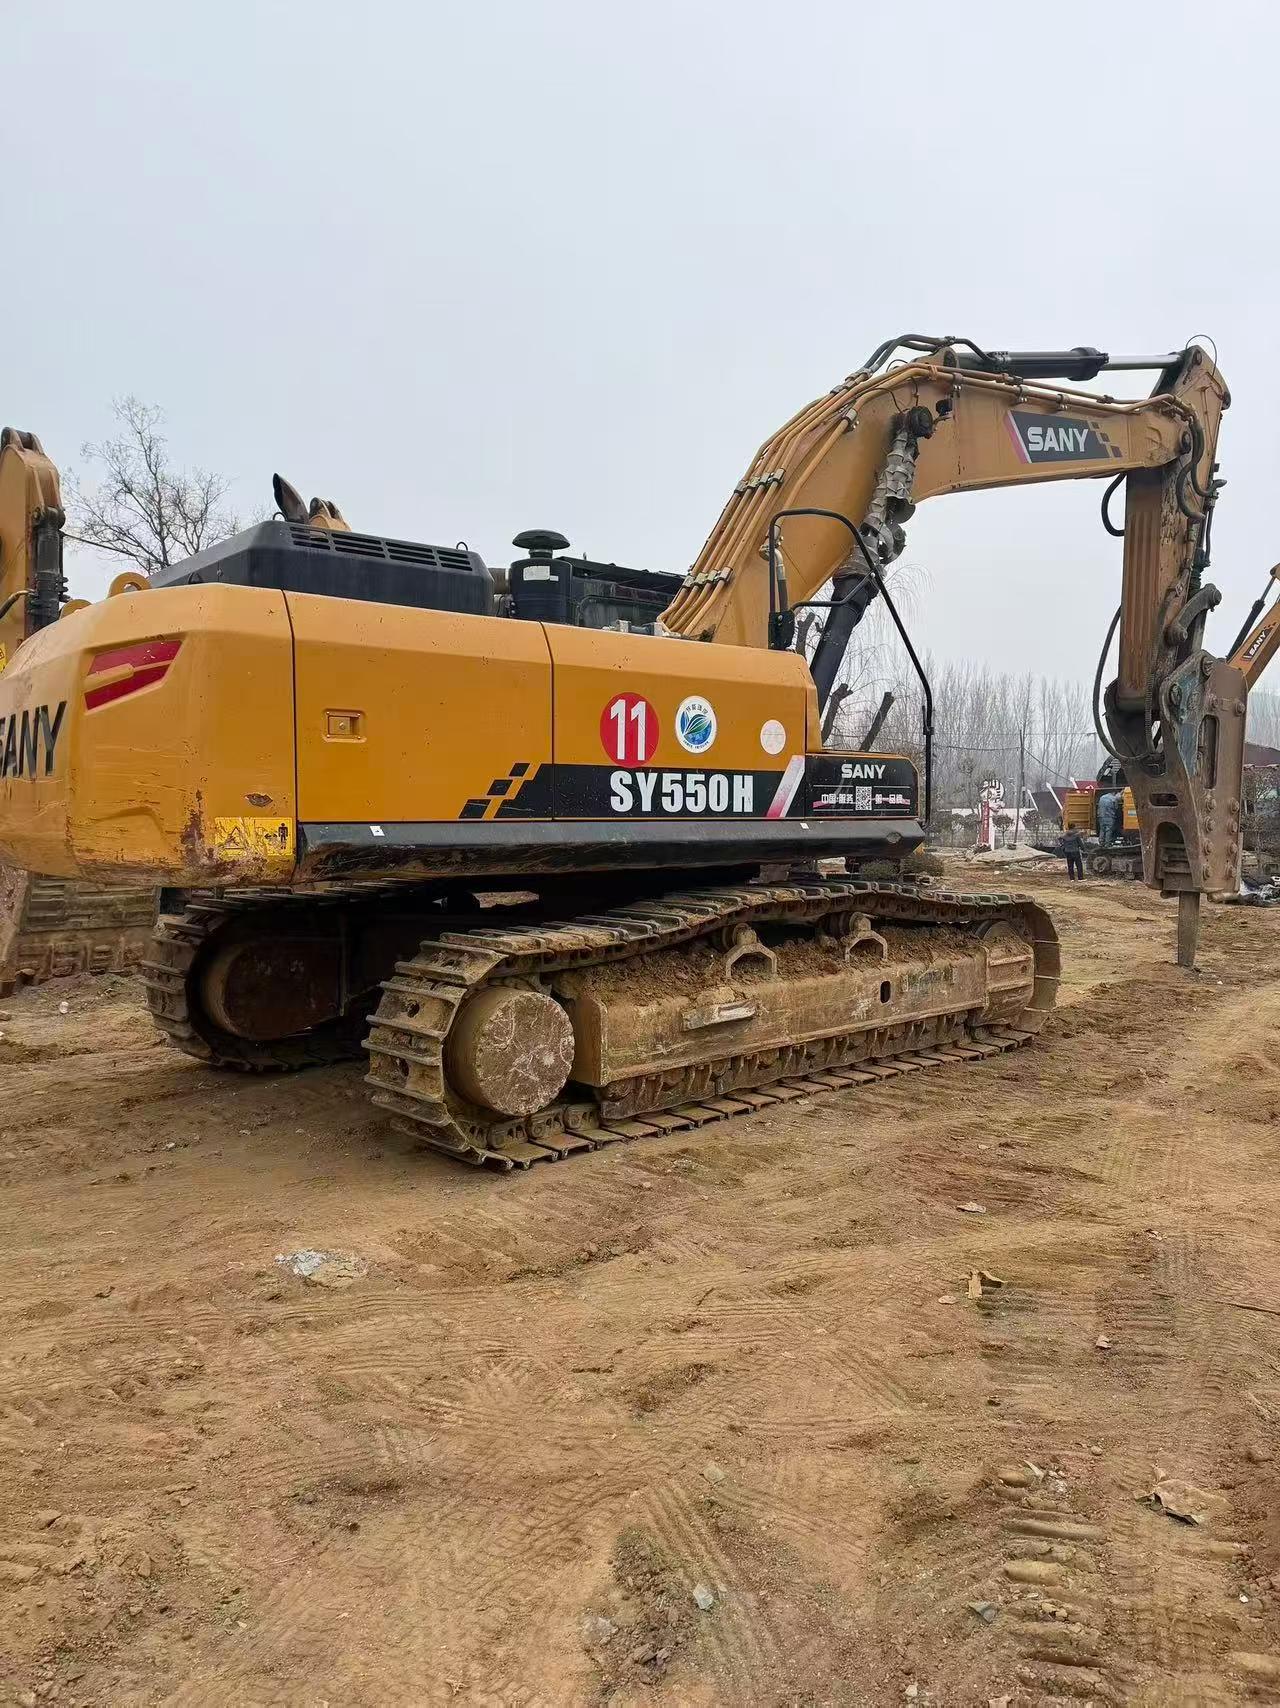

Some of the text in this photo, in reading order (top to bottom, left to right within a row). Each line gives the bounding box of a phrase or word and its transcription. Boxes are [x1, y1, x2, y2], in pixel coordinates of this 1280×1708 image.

[1027, 426, 1089, 452] SANY
[1249, 631, 1266, 656] SANY
[610, 699, 646, 761] 11
[841, 763, 886, 779] SANY
[610, 770, 754, 814] SY550H
